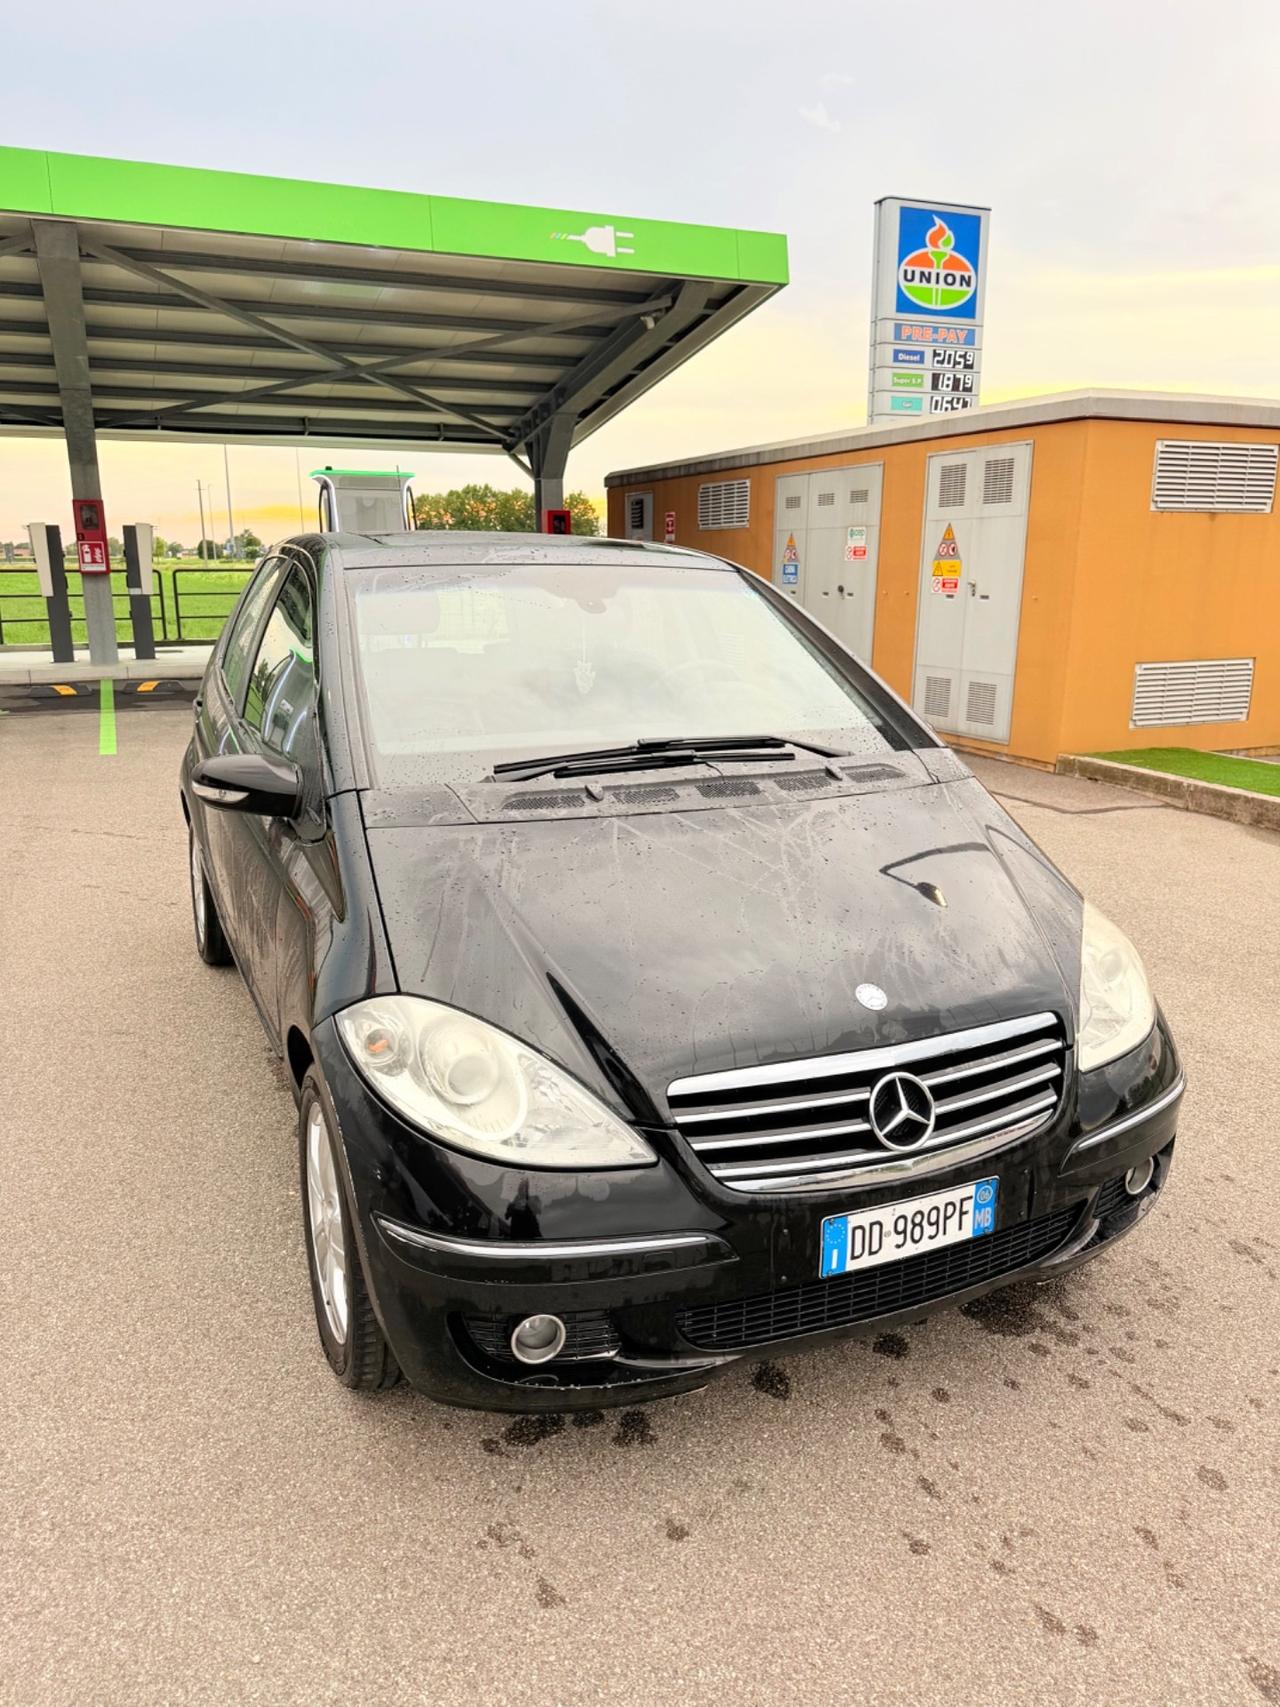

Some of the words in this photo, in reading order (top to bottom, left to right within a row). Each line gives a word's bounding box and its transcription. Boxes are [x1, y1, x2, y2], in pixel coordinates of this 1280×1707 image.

[903, 269, 972, 288] UNION
[901, 325, 968, 343] PRE-PAY
[898, 353, 920, 361] Diesel
[851, 1220, 883, 1260] DD
[893, 1196, 973, 1249] 989PF
[974, 1207, 992, 1229] MB
